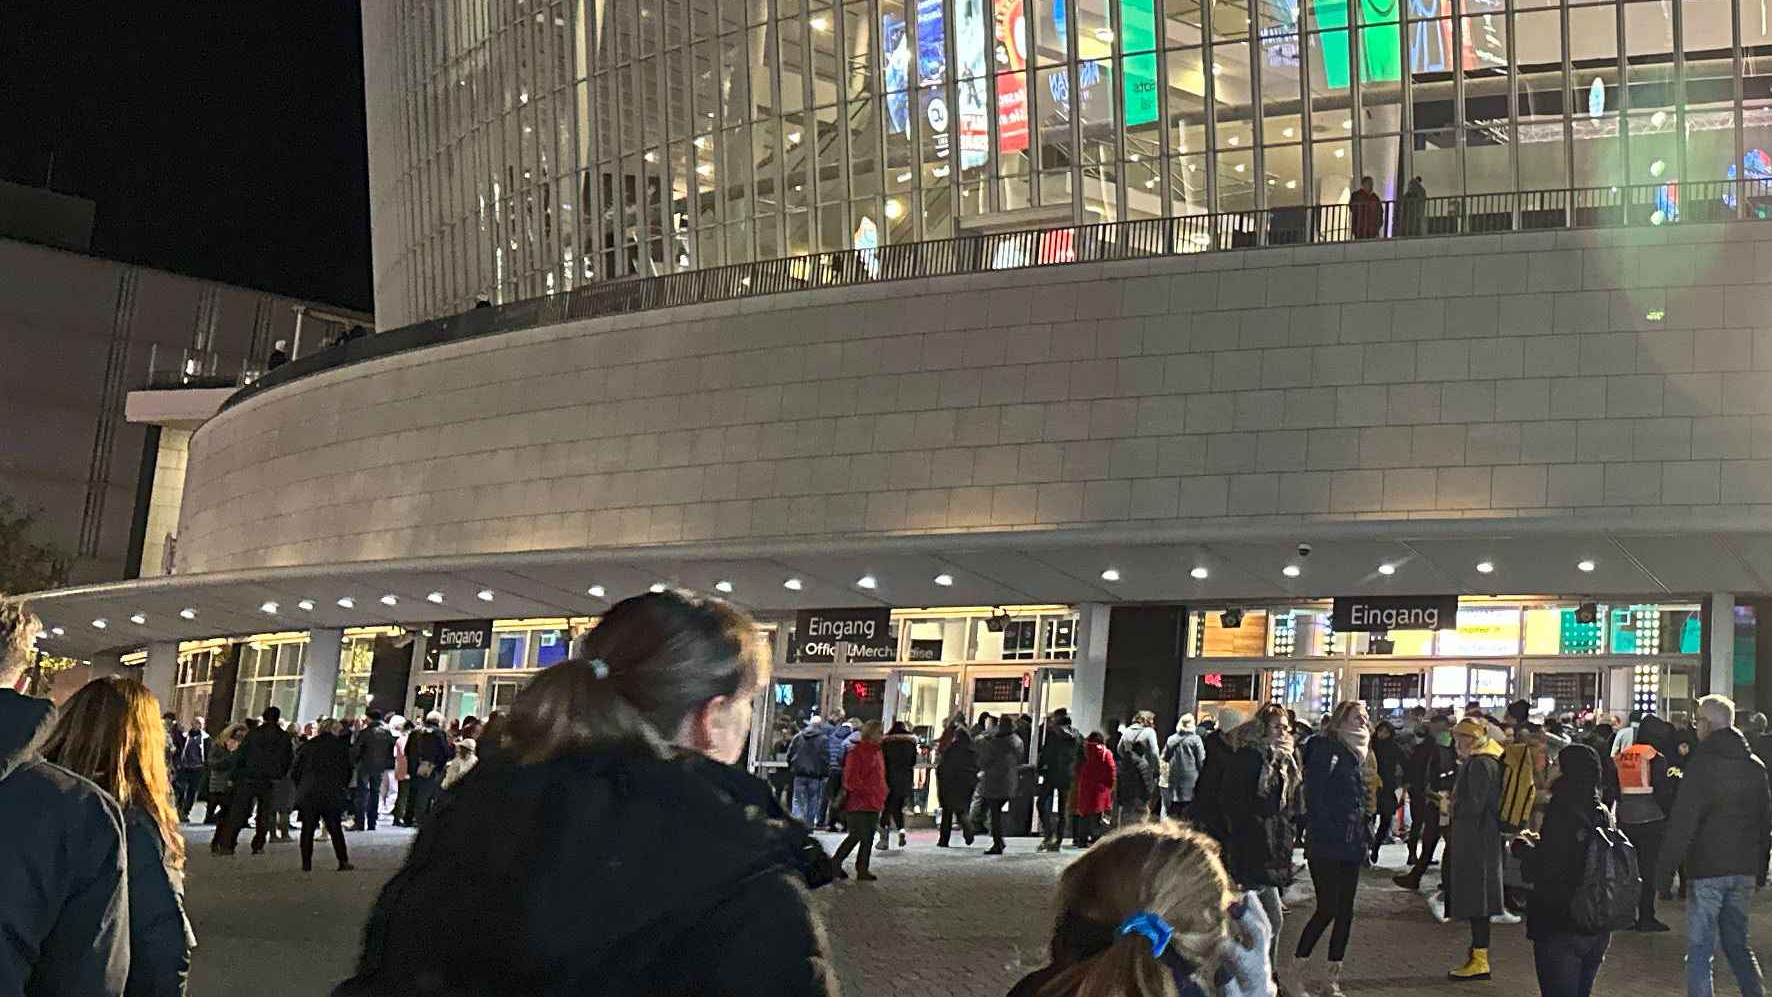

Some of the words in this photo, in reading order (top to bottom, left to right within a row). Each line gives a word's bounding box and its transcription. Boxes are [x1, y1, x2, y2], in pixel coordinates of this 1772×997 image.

[1350, 604, 1439, 628] Eingang
[439, 628, 484, 648] Eingang
[808, 617, 876, 640] Eingang
